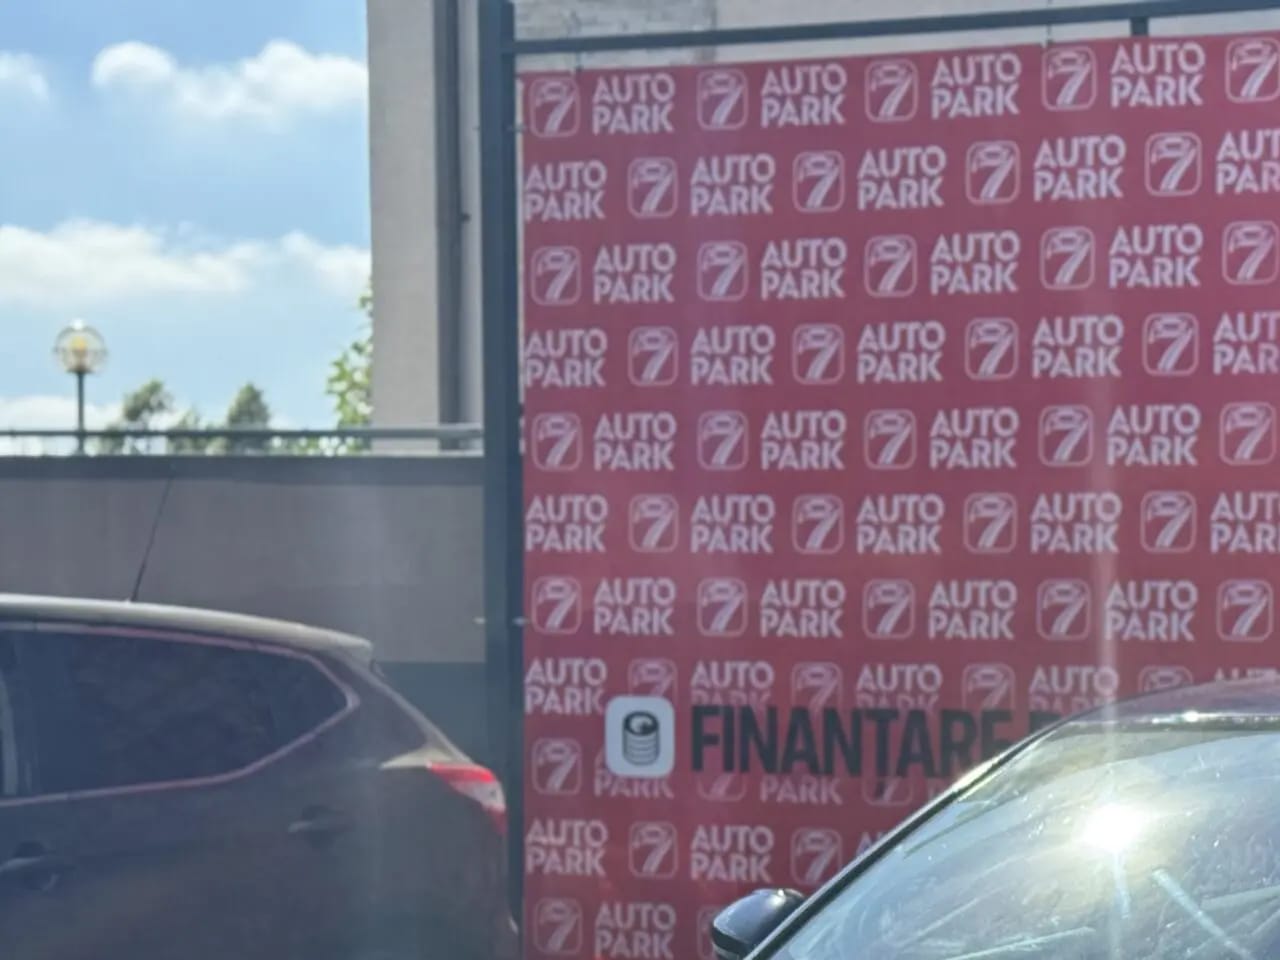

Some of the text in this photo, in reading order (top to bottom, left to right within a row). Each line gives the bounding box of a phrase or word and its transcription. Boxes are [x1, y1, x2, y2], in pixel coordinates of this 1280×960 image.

[931, 53, 1022, 86] AUTO
[1111, 41, 1205, 75] AUTO
[593, 73, 675, 102] AUTO
[761, 63, 847, 96] AUTO
[1111, 75, 1204, 108] PARK
[761, 96, 846, 128] PARK
[931, 85, 1020, 118] PARK
[592, 103, 673, 135] PARK
[857, 145, 946, 179] AUTO
[1034, 135, 1126, 168] AUTO
[524, 160, 607, 192] AUTO
[690, 153, 776, 186] AUTO
[1033, 167, 1123, 201] PARK
[524, 192, 606, 222] PARK
[690, 184, 773, 217] PARK
[857, 178, 944, 211] PARK
[761, 237, 847, 270] AUTO
[931, 230, 1020, 263] AUTO
[1109, 224, 1203, 257] AUTO
[594, 242, 676, 272] AUTO
[1109, 256, 1200, 289] PARK
[594, 272, 674, 304] PARK
[760, 269, 846, 300] PARK
[930, 262, 1018, 295] PARK
[524, 328, 607, 359] AUTO
[690, 325, 775, 356] AUTO
[857, 321, 946, 355] AUTO
[1033, 314, 1123, 346] AUTO
[524, 357, 606, 388] PARK
[690, 354, 773, 385] PARK
[857, 352, 943, 383] PARK
[1032, 345, 1121, 379] PARK
[594, 411, 677, 441] AUTO
[761, 409, 846, 440] AUTO
[930, 407, 1019, 439] AUTO
[1107, 404, 1200, 434] AUTO
[594, 440, 675, 471] PARK
[761, 440, 844, 471] PARK
[930, 438, 1017, 470] PARK
[1106, 434, 1198, 467] PARK
[524, 494, 608, 524] AUTO
[691, 494, 775, 525] AUTO
[857, 494, 944, 525] AUTO
[1031, 492, 1122, 523] AUTO
[524, 523, 606, 554] PARK
[691, 523, 773, 555] PARK
[857, 523, 942, 555] PARK
[1030, 521, 1119, 554] PARK
[594, 578, 676, 608] AUTO
[761, 579, 845, 609] AUTO
[929, 579, 1017, 611] AUTO
[1106, 580, 1198, 611] AUTO
[594, 606, 674, 637] PARK
[760, 607, 843, 639] PARK
[929, 609, 1015, 640] PARK
[1105, 611, 1196, 642] PARK
[524, 658, 607, 687] AUTO
[691, 661, 774, 690] AUTO
[857, 664, 942, 694] AUTO
[1029, 665, 1119, 696] AUTO
[524, 685, 605, 715] PARK
[524, 820, 608, 848] AUTO
[691, 824, 774, 854] AUTO
[524, 846, 606, 876] PARK
[691, 854, 772, 884] PARK
[595, 903, 676, 933] AUTO
[595, 931, 674, 960] PARK
